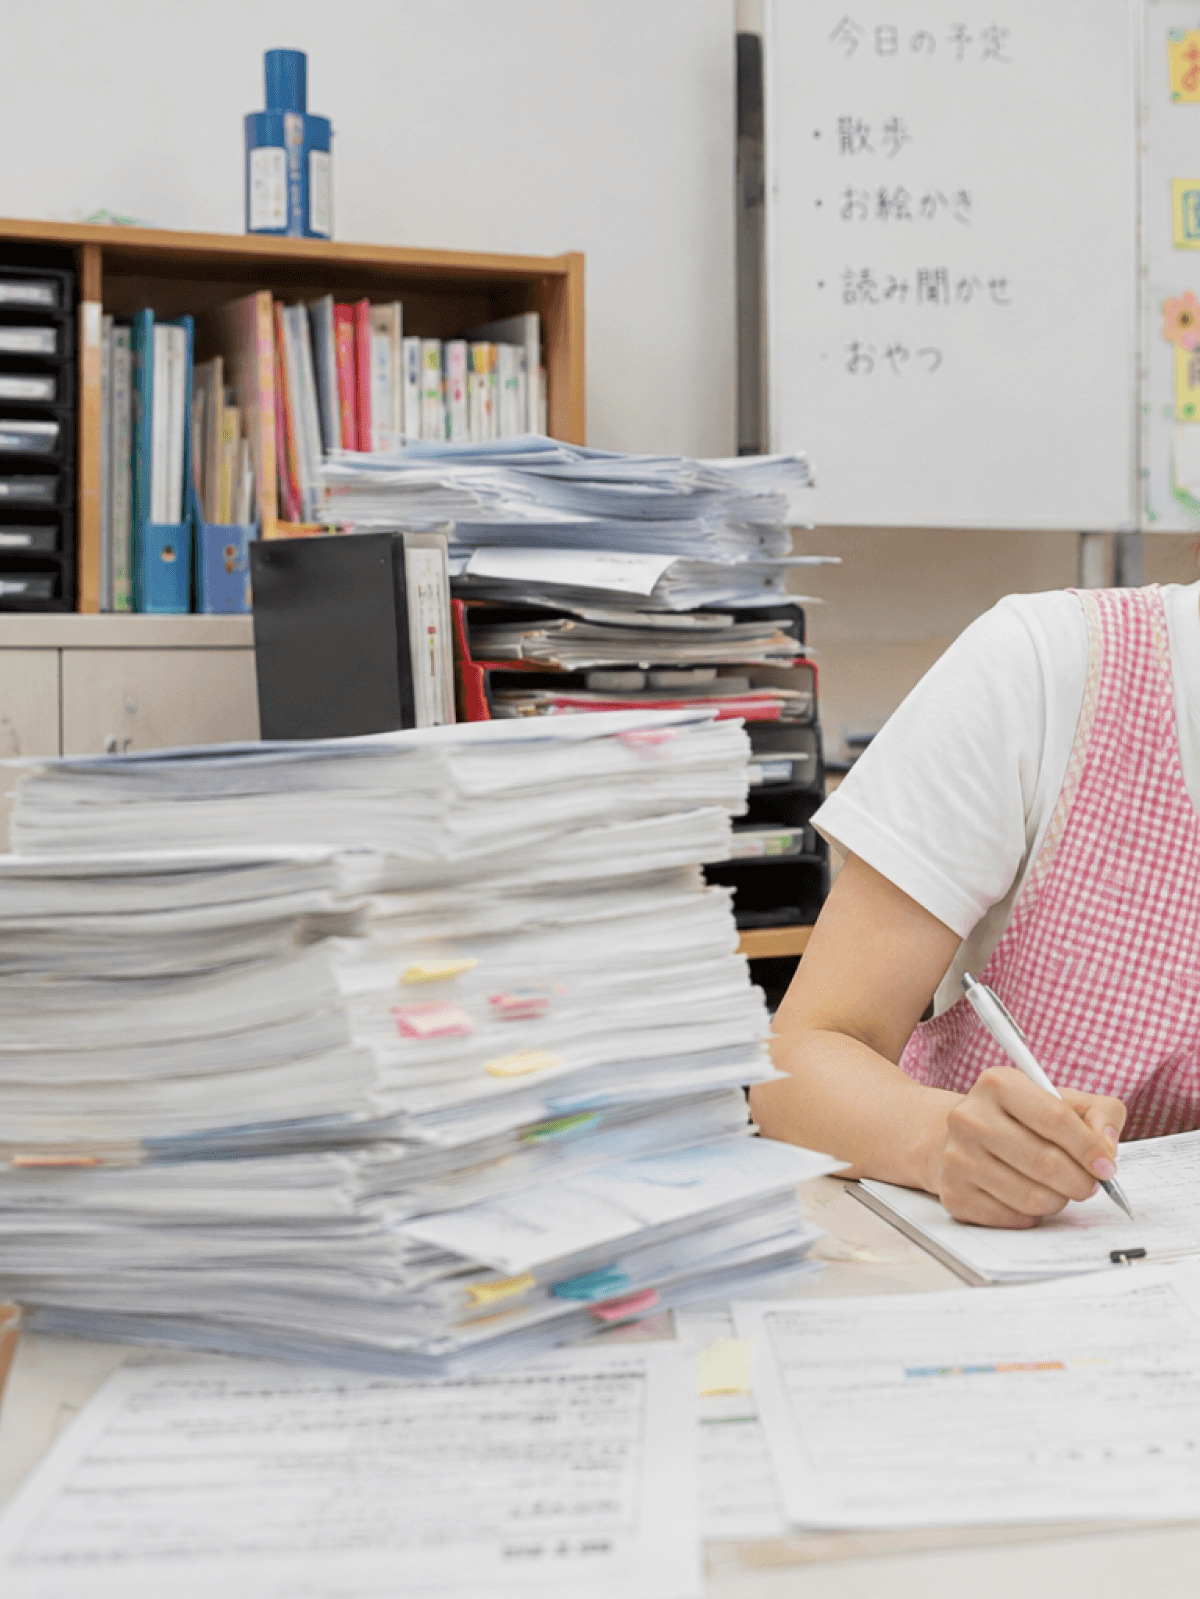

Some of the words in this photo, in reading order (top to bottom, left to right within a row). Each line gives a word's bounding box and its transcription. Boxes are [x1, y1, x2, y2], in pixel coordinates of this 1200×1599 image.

[828, 14, 1014, 63] 今日の予定
[837, 115, 912, 160] 散歩
[839, 185, 973, 225] お絵かき
[845, 341, 944, 375] おやつ
